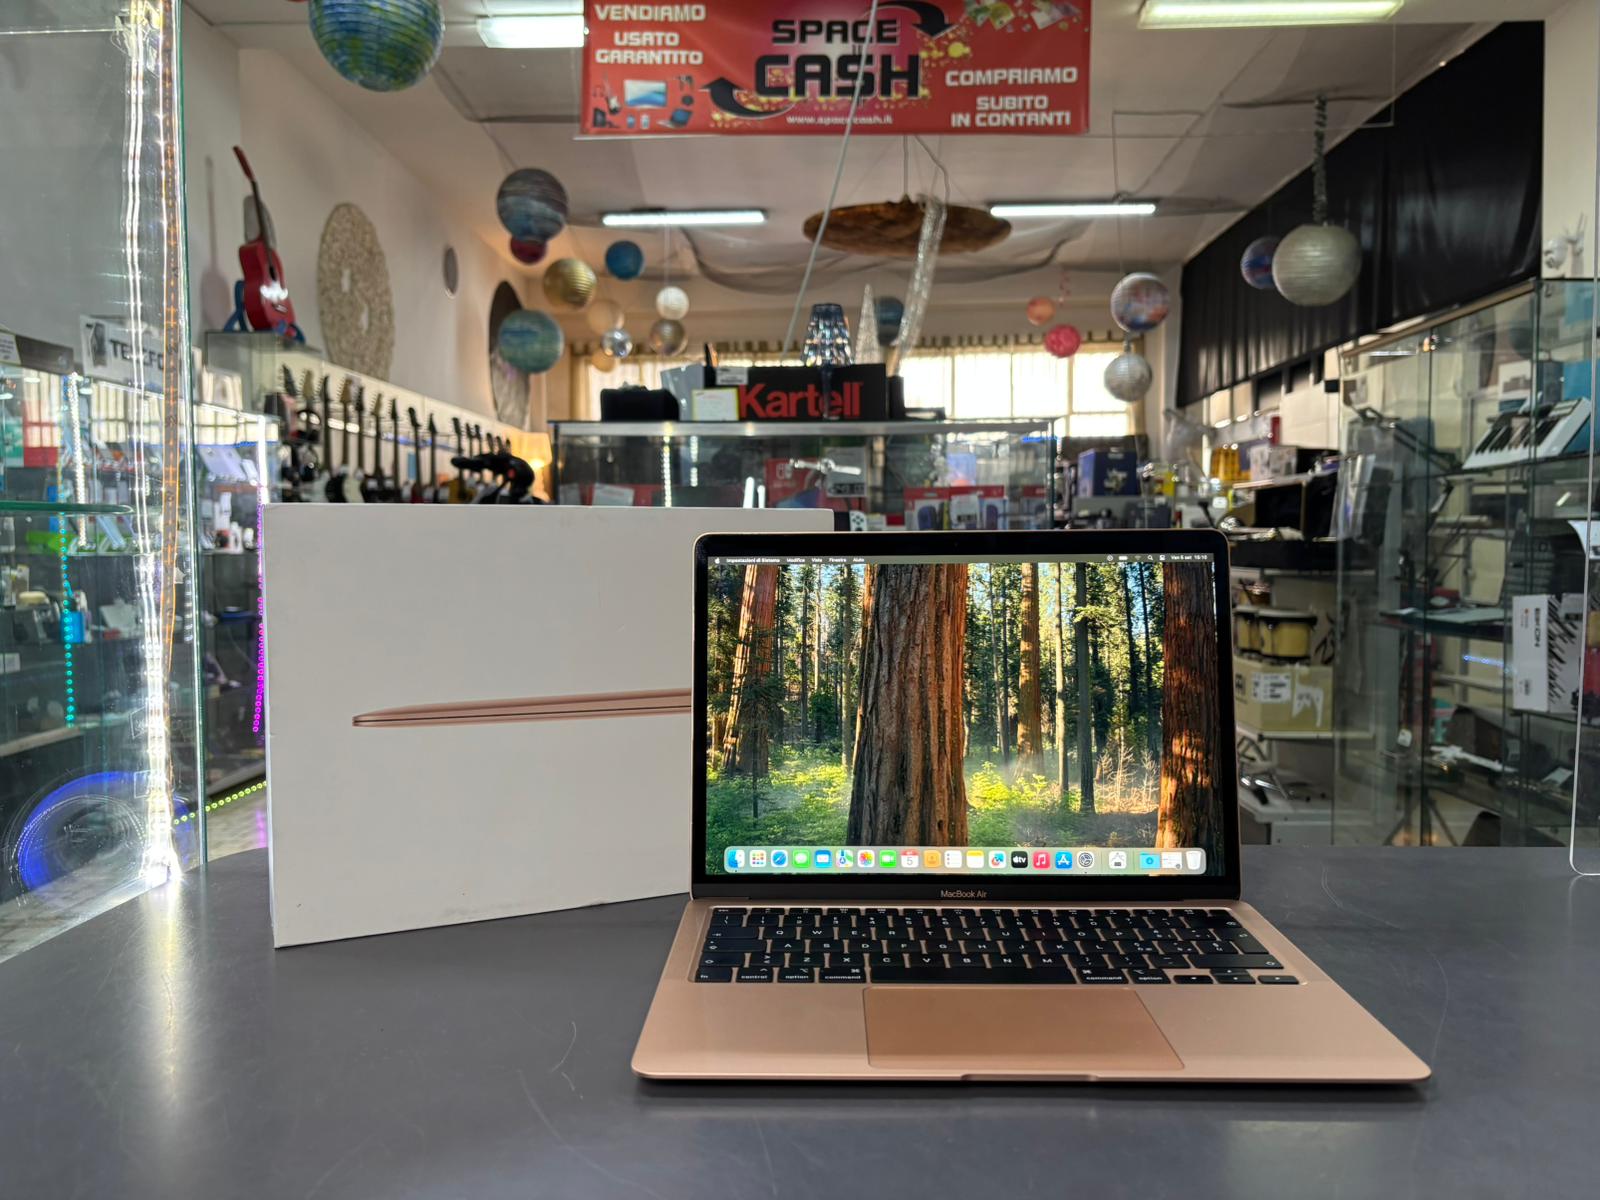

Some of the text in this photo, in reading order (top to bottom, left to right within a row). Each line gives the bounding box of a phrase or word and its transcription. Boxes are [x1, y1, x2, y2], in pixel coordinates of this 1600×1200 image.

[594, 4, 706, 22] VENDIAMO
[613, 31, 680, 46] USATO
[772, 19, 897, 44] SPACE
[595, 49, 704, 65] GARANTITO
[755, 54, 920, 97] CASH
[945, 67, 1078, 87] COMPRIAMO
[975, 95, 1049, 111] SUBITO
[950, 111, 1072, 128] IN CONTANTI
[738, 381, 863, 419] Kartell
[906, 856, 914, 866] 5
[940, 889, 988, 898] MacBook Air
